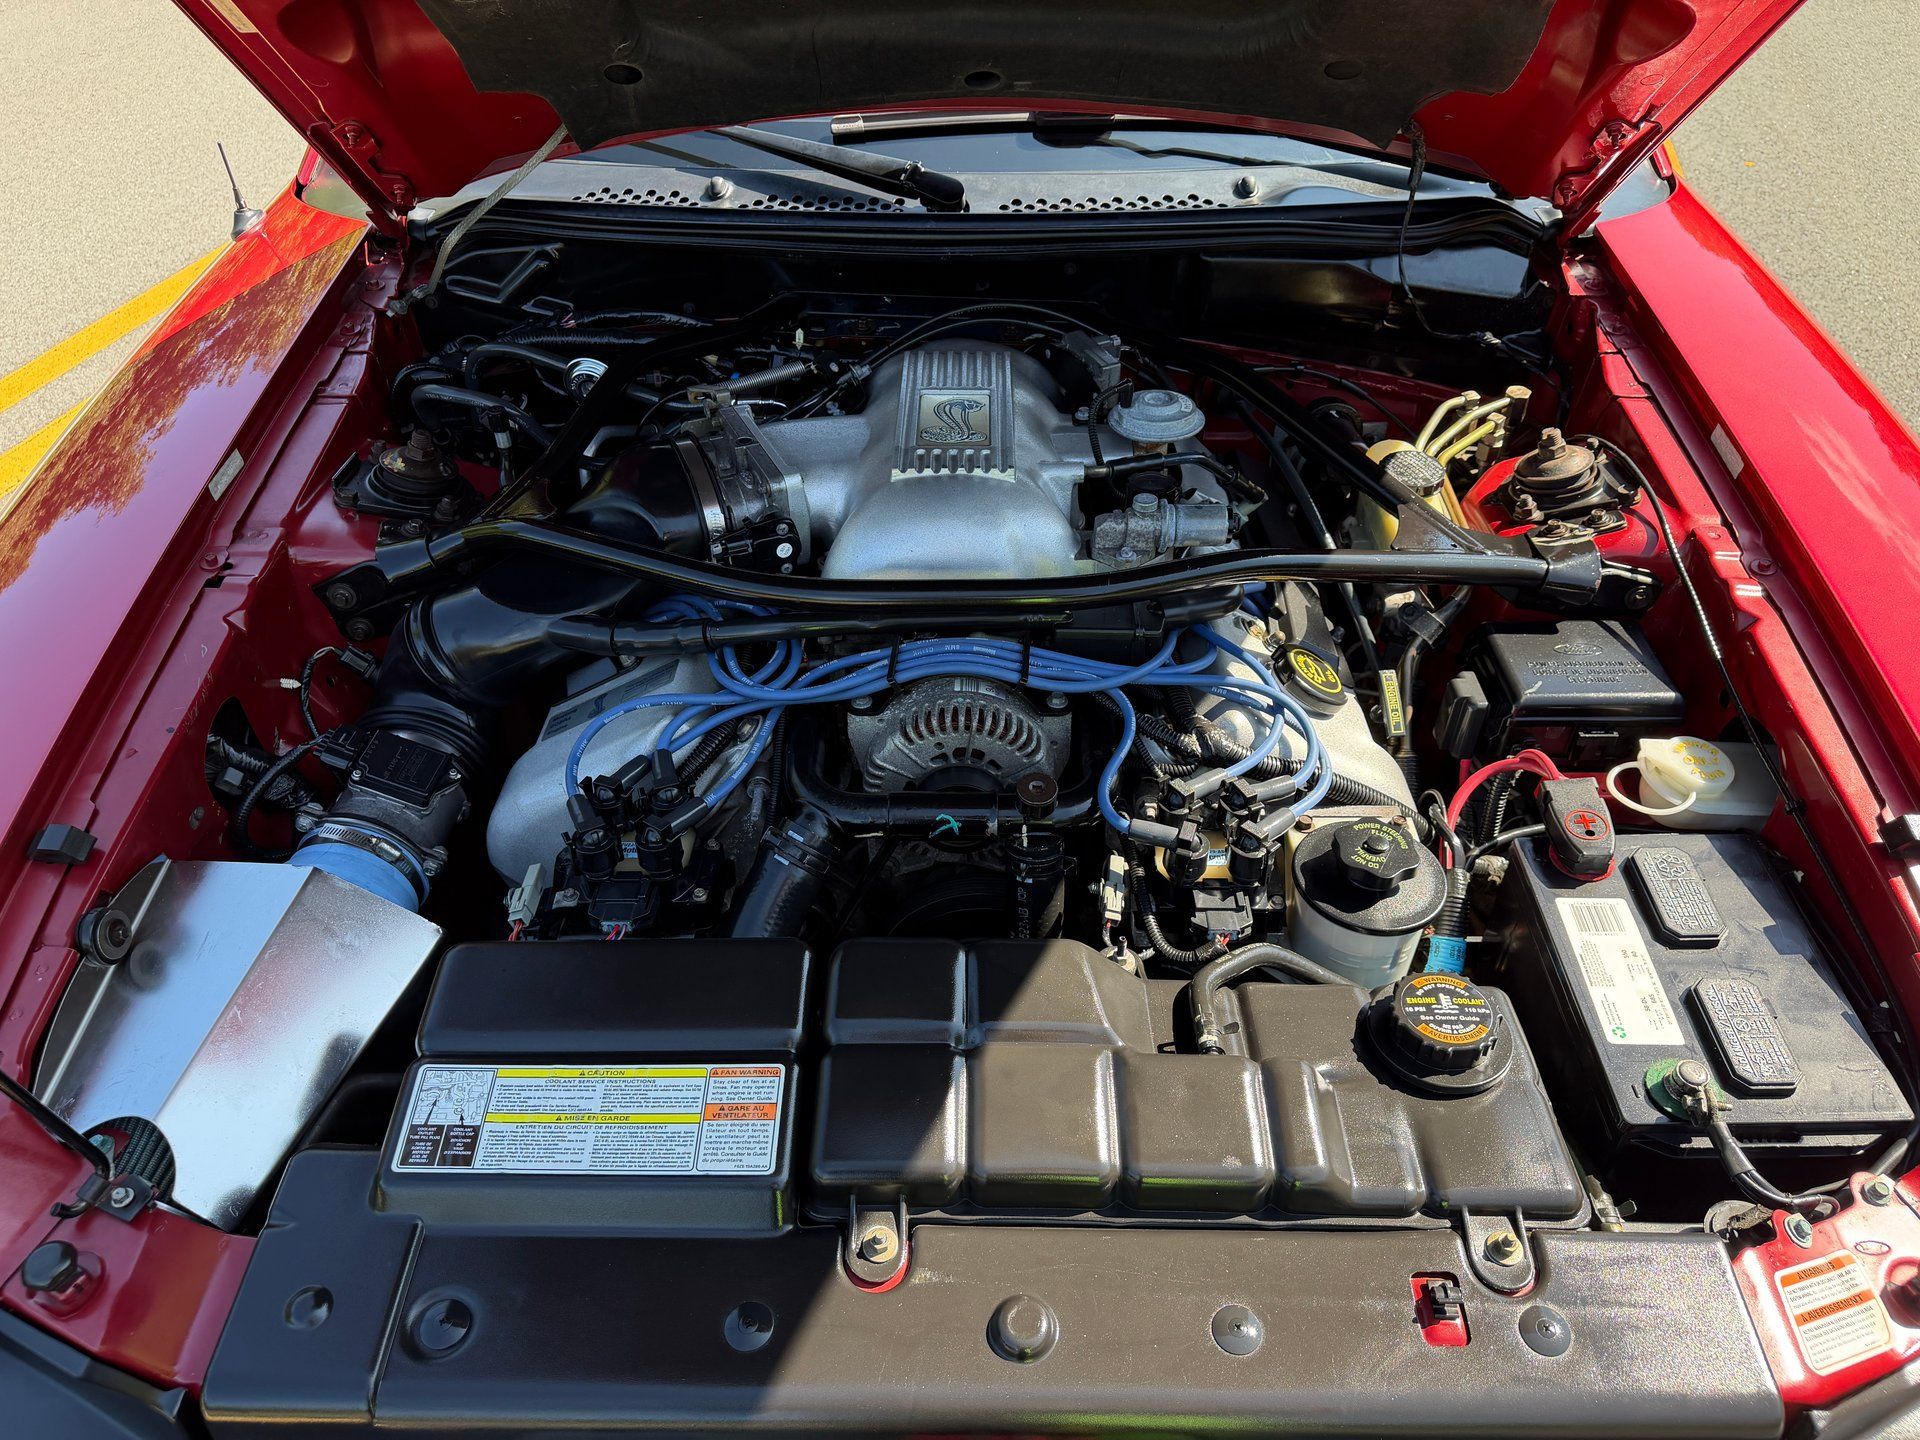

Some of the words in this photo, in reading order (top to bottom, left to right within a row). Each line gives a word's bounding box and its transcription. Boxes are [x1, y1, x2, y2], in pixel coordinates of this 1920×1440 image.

[1386, 680, 1398, 710] ENGINE
[1391, 711, 1401, 726] OIL
[1354, 822, 1380, 831] POWER
[1382, 825, 1408, 850] STEERING
[1371, 830, 1393, 841] FLUID
[1350, 855, 1366, 865] NOT
[1423, 977, 1462, 986] WARNING
[1456, 988, 1470, 996] HOT
[1428, 1027, 1485, 1041] AVERTISSEMENT
[1808, 1293, 1864, 1320] AVERTISSEMENT
